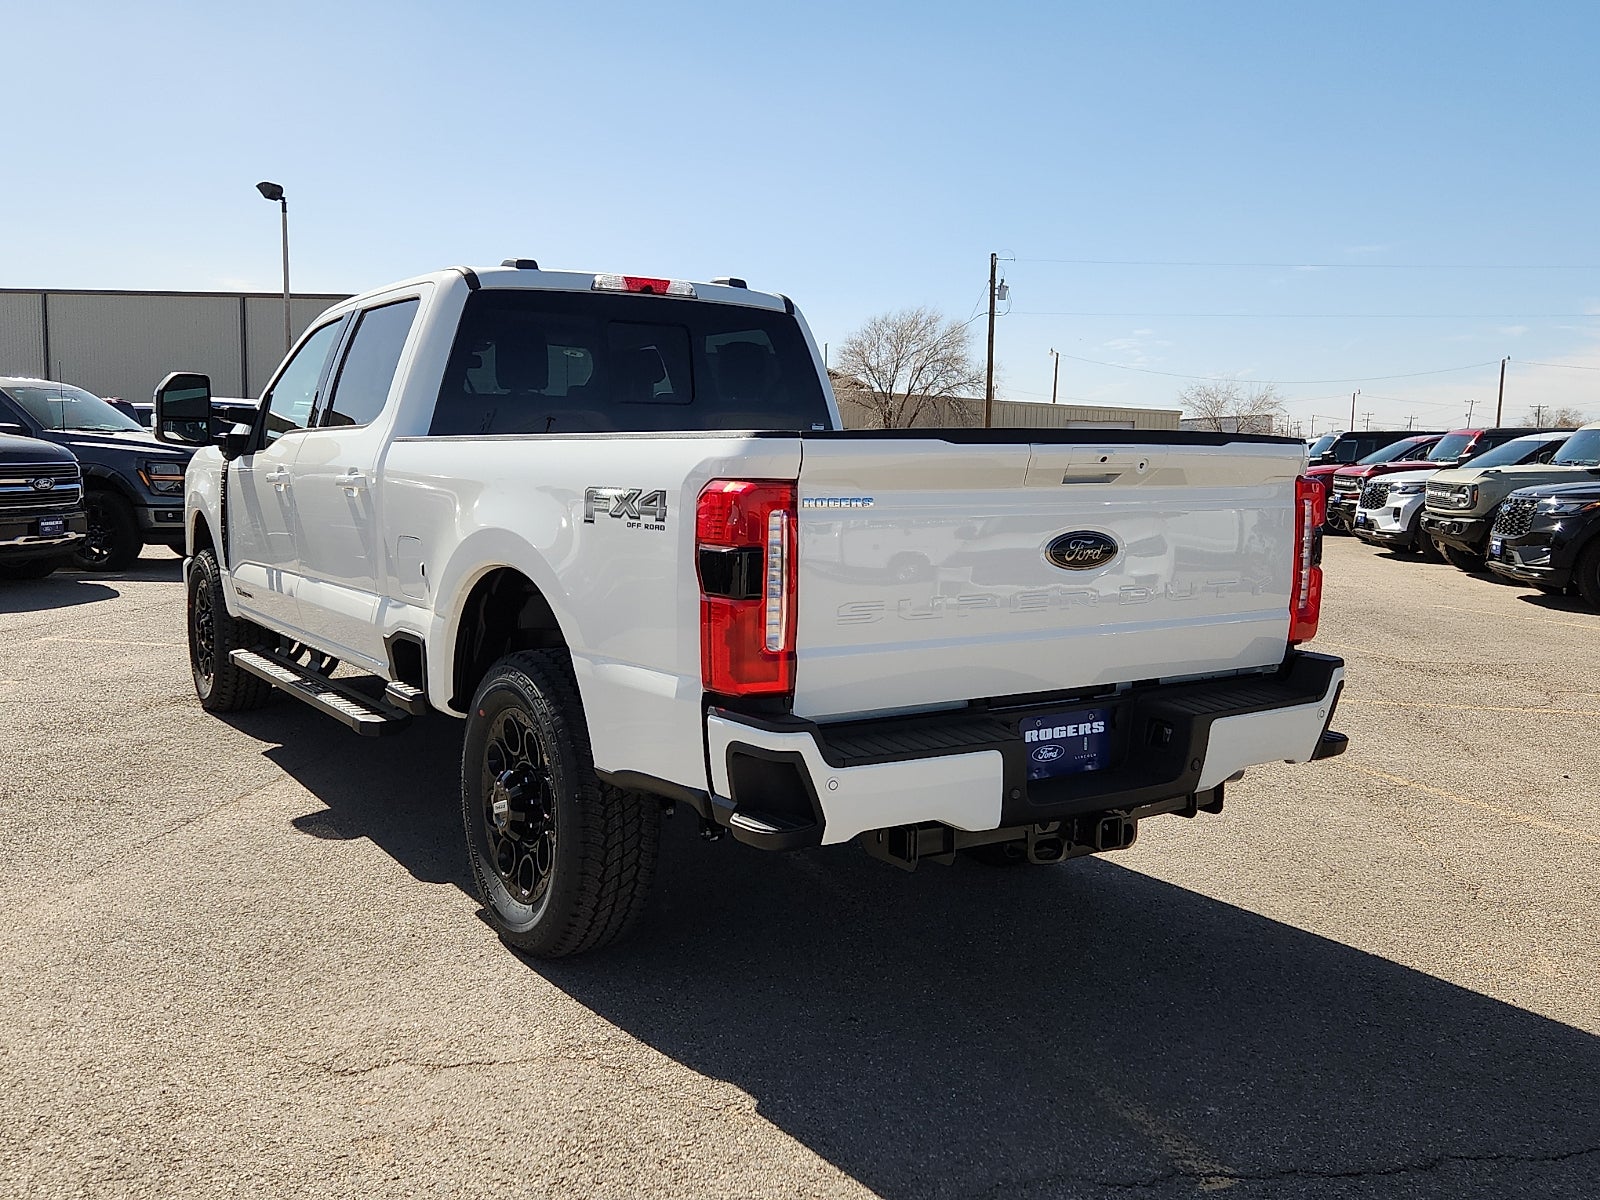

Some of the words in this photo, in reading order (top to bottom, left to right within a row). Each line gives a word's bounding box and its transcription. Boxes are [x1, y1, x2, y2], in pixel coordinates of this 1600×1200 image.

[583, 486, 667, 523] FX4
[802, 497, 874, 508] ROGERS
[626, 521, 642, 529] OFF
[644, 523, 666, 531] ROAD
[1065, 539, 1105, 562] Ford
[1024, 720, 1105, 743] ROGERS
[1037, 746, 1059, 760] Ford
